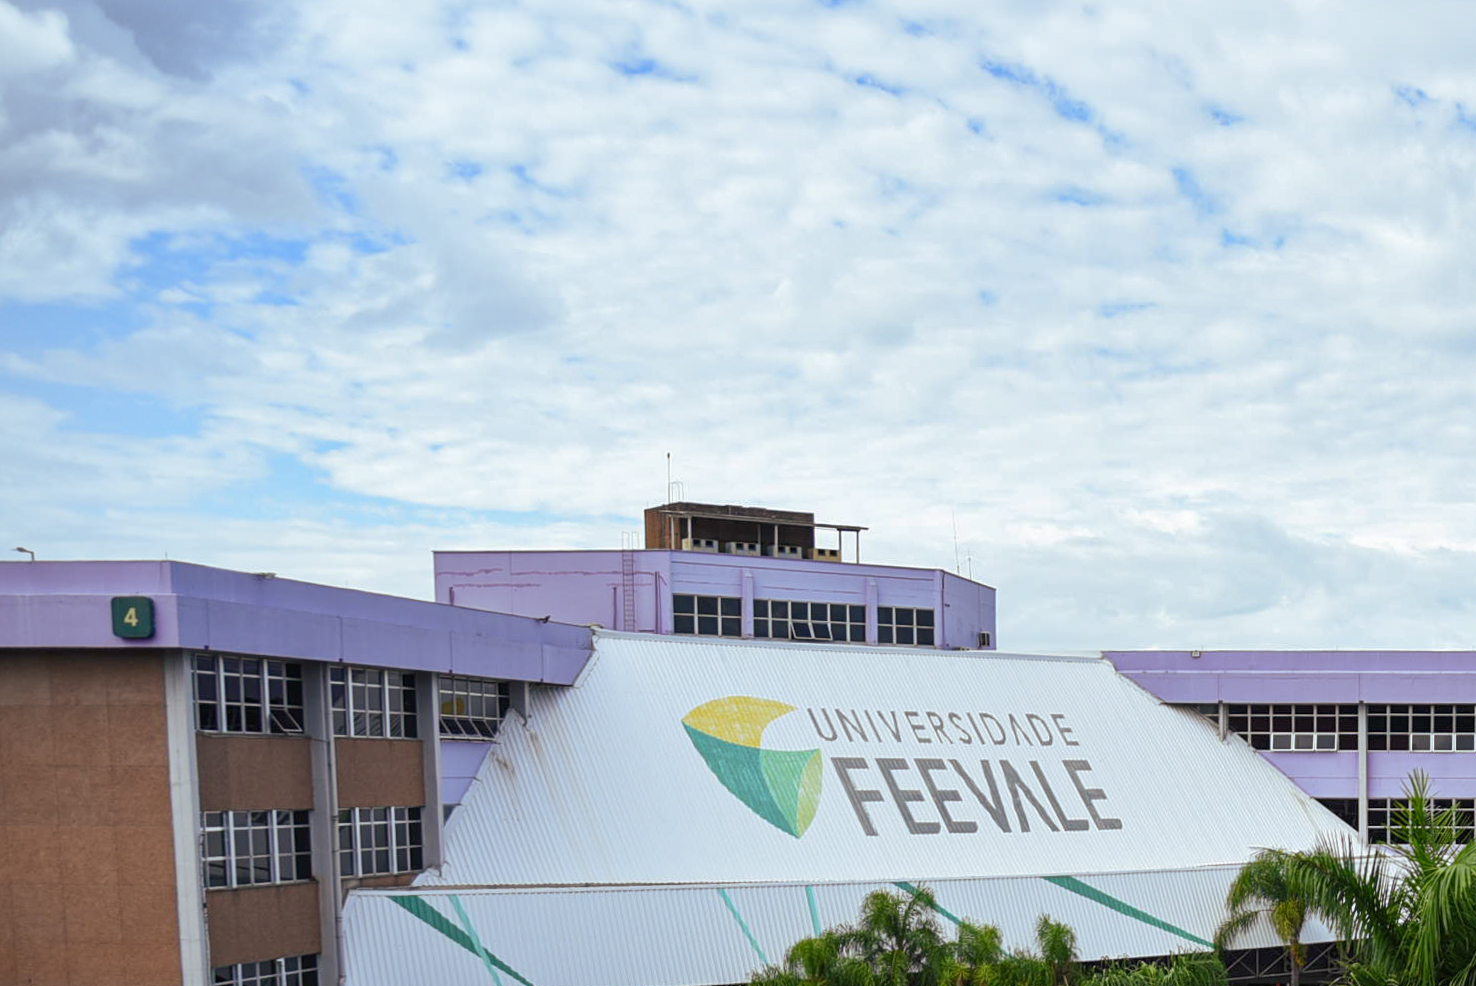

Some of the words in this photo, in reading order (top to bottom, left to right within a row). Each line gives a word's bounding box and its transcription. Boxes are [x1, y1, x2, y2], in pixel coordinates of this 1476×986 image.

[124, 607, 139, 627] 4
[807, 708, 1080, 746] UNIVERSIDADE
[830, 756, 1123, 836] FEEVALE
